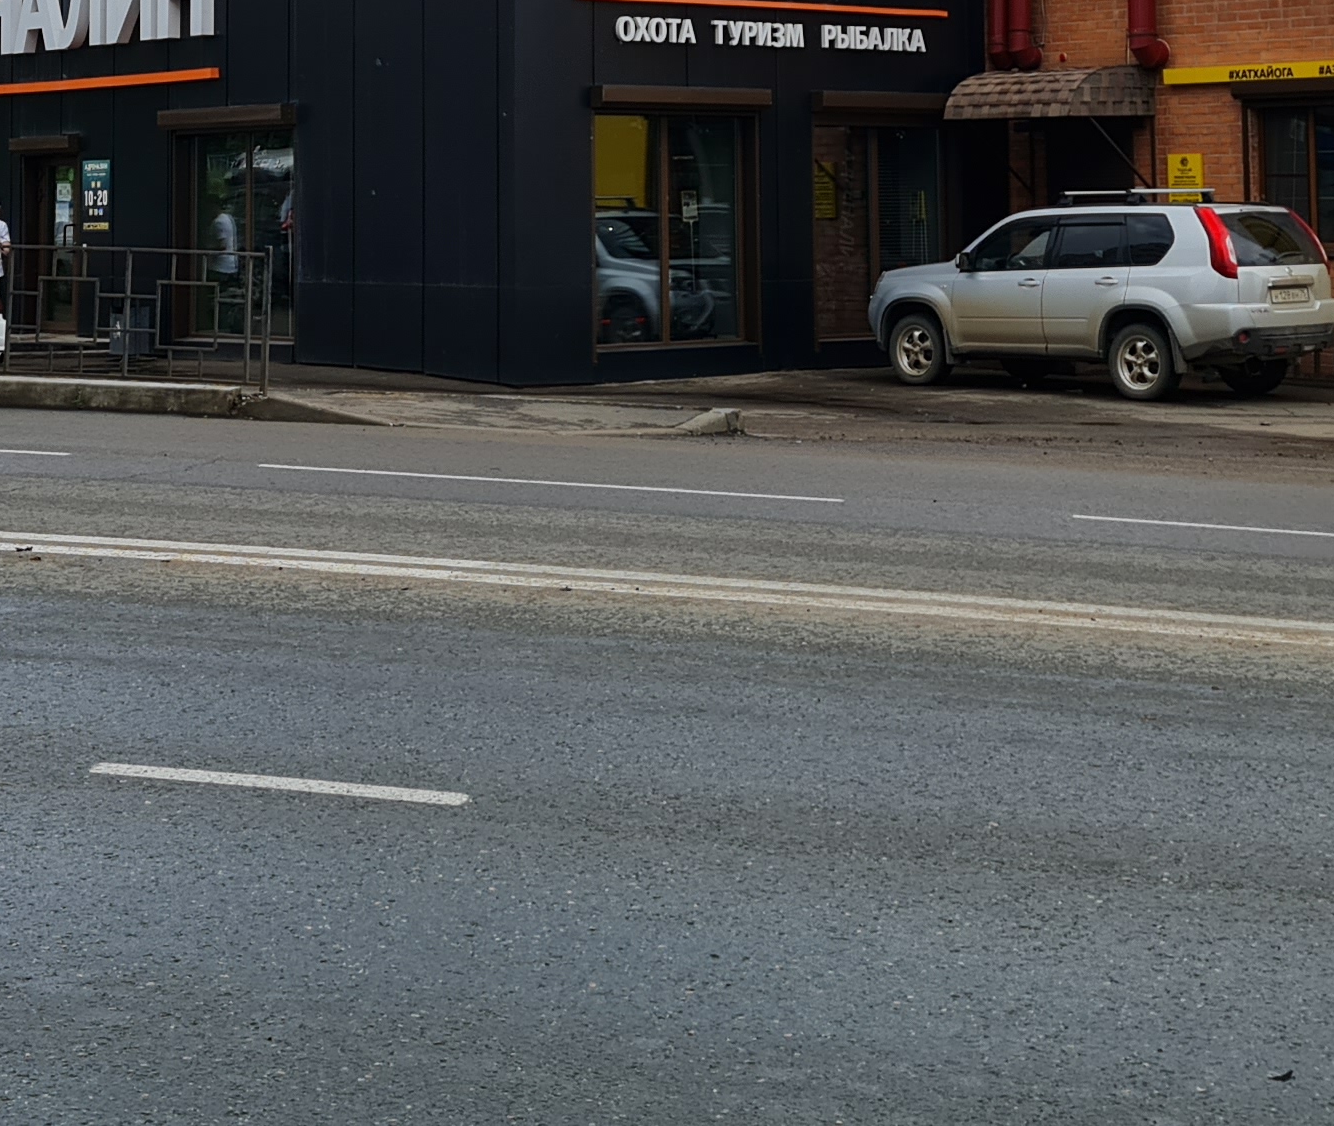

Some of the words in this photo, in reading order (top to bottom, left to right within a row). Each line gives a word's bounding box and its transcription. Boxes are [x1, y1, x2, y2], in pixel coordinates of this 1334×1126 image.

[615, 15, 696, 45] ОХОТА
[711, 19, 805, 49] ТУРИЗМ
[821, 24, 927, 54] РЫБАЛКА
[1228, 66, 1294, 80] #ХАТХАЙОГА
